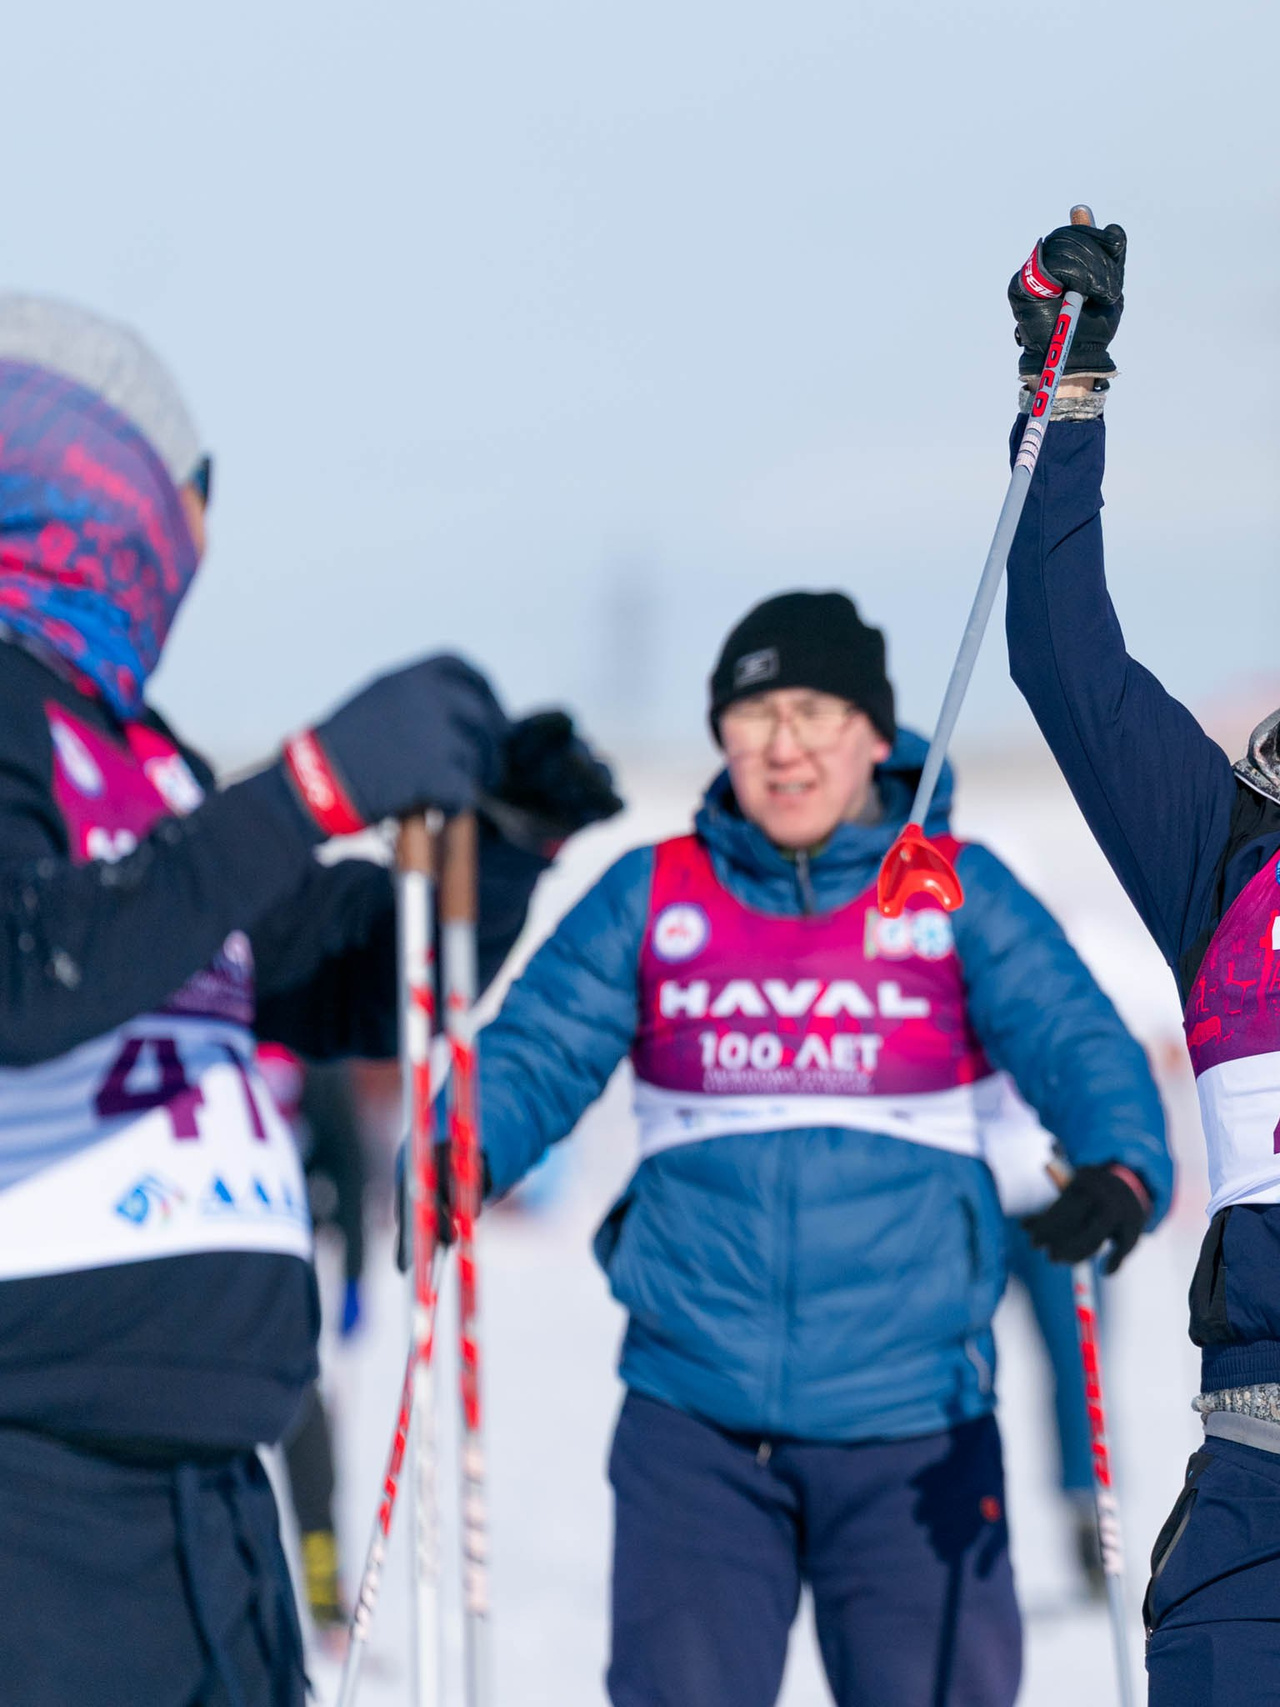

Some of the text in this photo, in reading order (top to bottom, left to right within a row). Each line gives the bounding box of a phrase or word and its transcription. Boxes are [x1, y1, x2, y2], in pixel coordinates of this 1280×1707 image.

[660, 980, 930, 1018] HAVAL
[699, 1031, 884, 1073] 100 ЛЕТ
